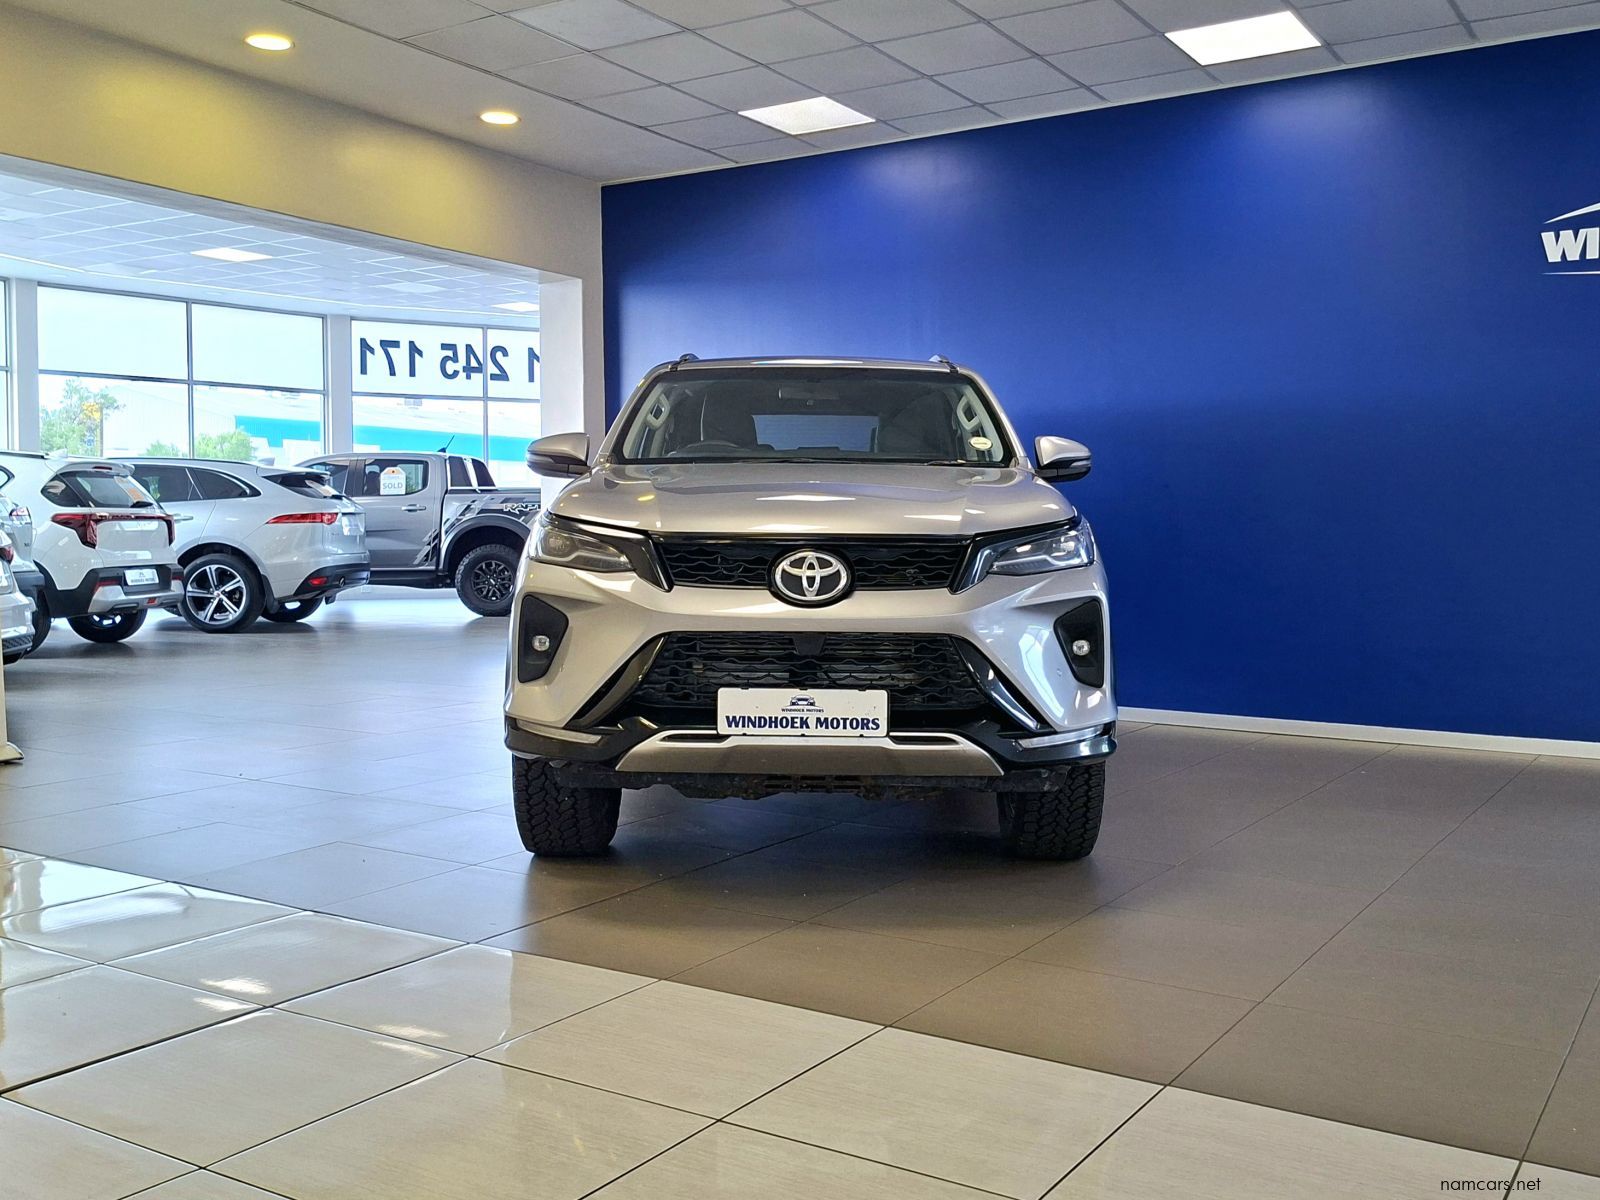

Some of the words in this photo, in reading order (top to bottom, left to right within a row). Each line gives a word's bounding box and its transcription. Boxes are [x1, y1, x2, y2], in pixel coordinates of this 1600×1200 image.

[382, 482, 404, 490] SOLD
[725, 715, 810, 730] WINDHOEK
[815, 717, 880, 731] MOTORS
